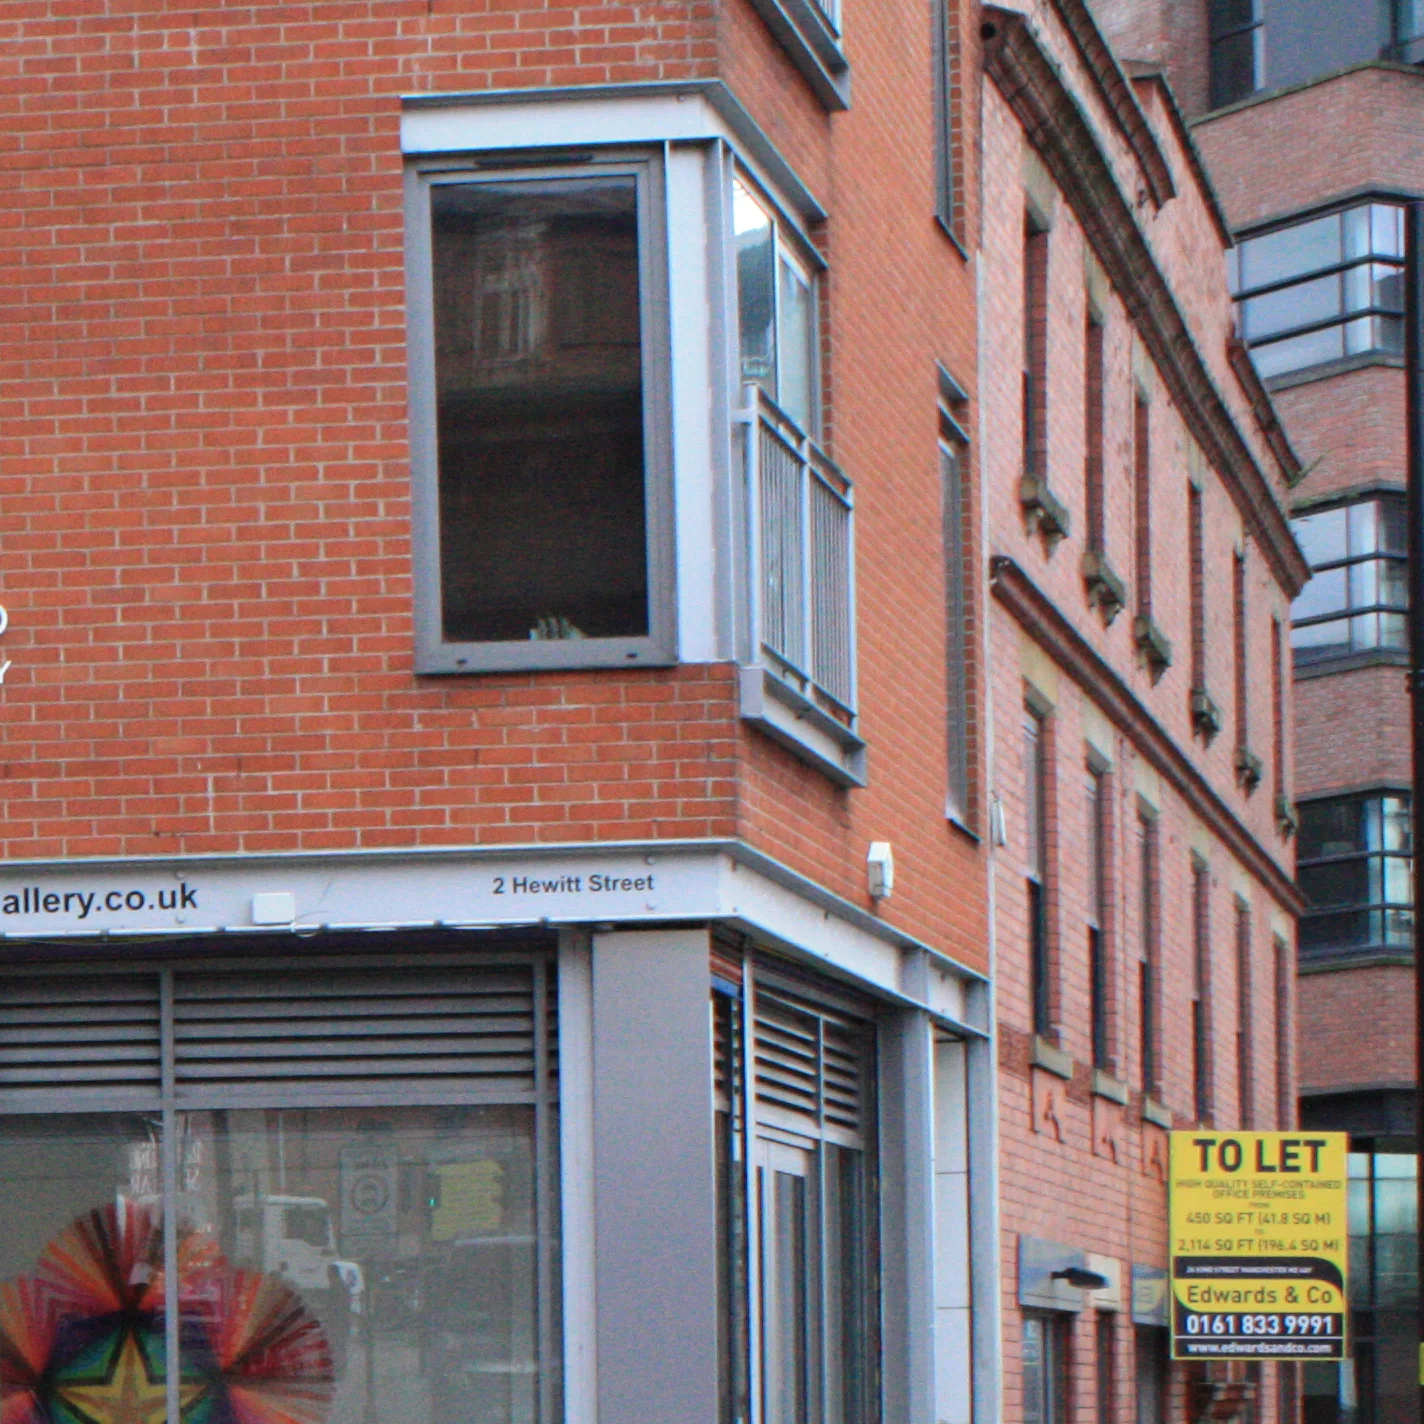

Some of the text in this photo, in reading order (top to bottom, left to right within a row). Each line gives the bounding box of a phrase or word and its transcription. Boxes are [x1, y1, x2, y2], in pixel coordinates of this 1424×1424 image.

[491, 873, 656, 895] 2 Hewitt Street
[1193, 1138, 1327, 1174] TO LET
[1205, 1179, 1249, 1190] QUALITY
[1252, 1179, 1342, 1190] SELF-CONTAINED
[1212, 1189, 1306, 1199] OFFICE PREMISES
[1186, 1211, 1332, 1225] 450 SQ FT (41.8 SQ M)
[1178, 1239, 1340, 1252] 2,114 SQ FT (196.4 SQ M)
[1187, 1284, 1334, 1304] Edwards & Co
[1185, 1314, 1334, 1335] 0161 833 9991
[1186, 1341, 1333, 1354] www.edwardsandco.com
